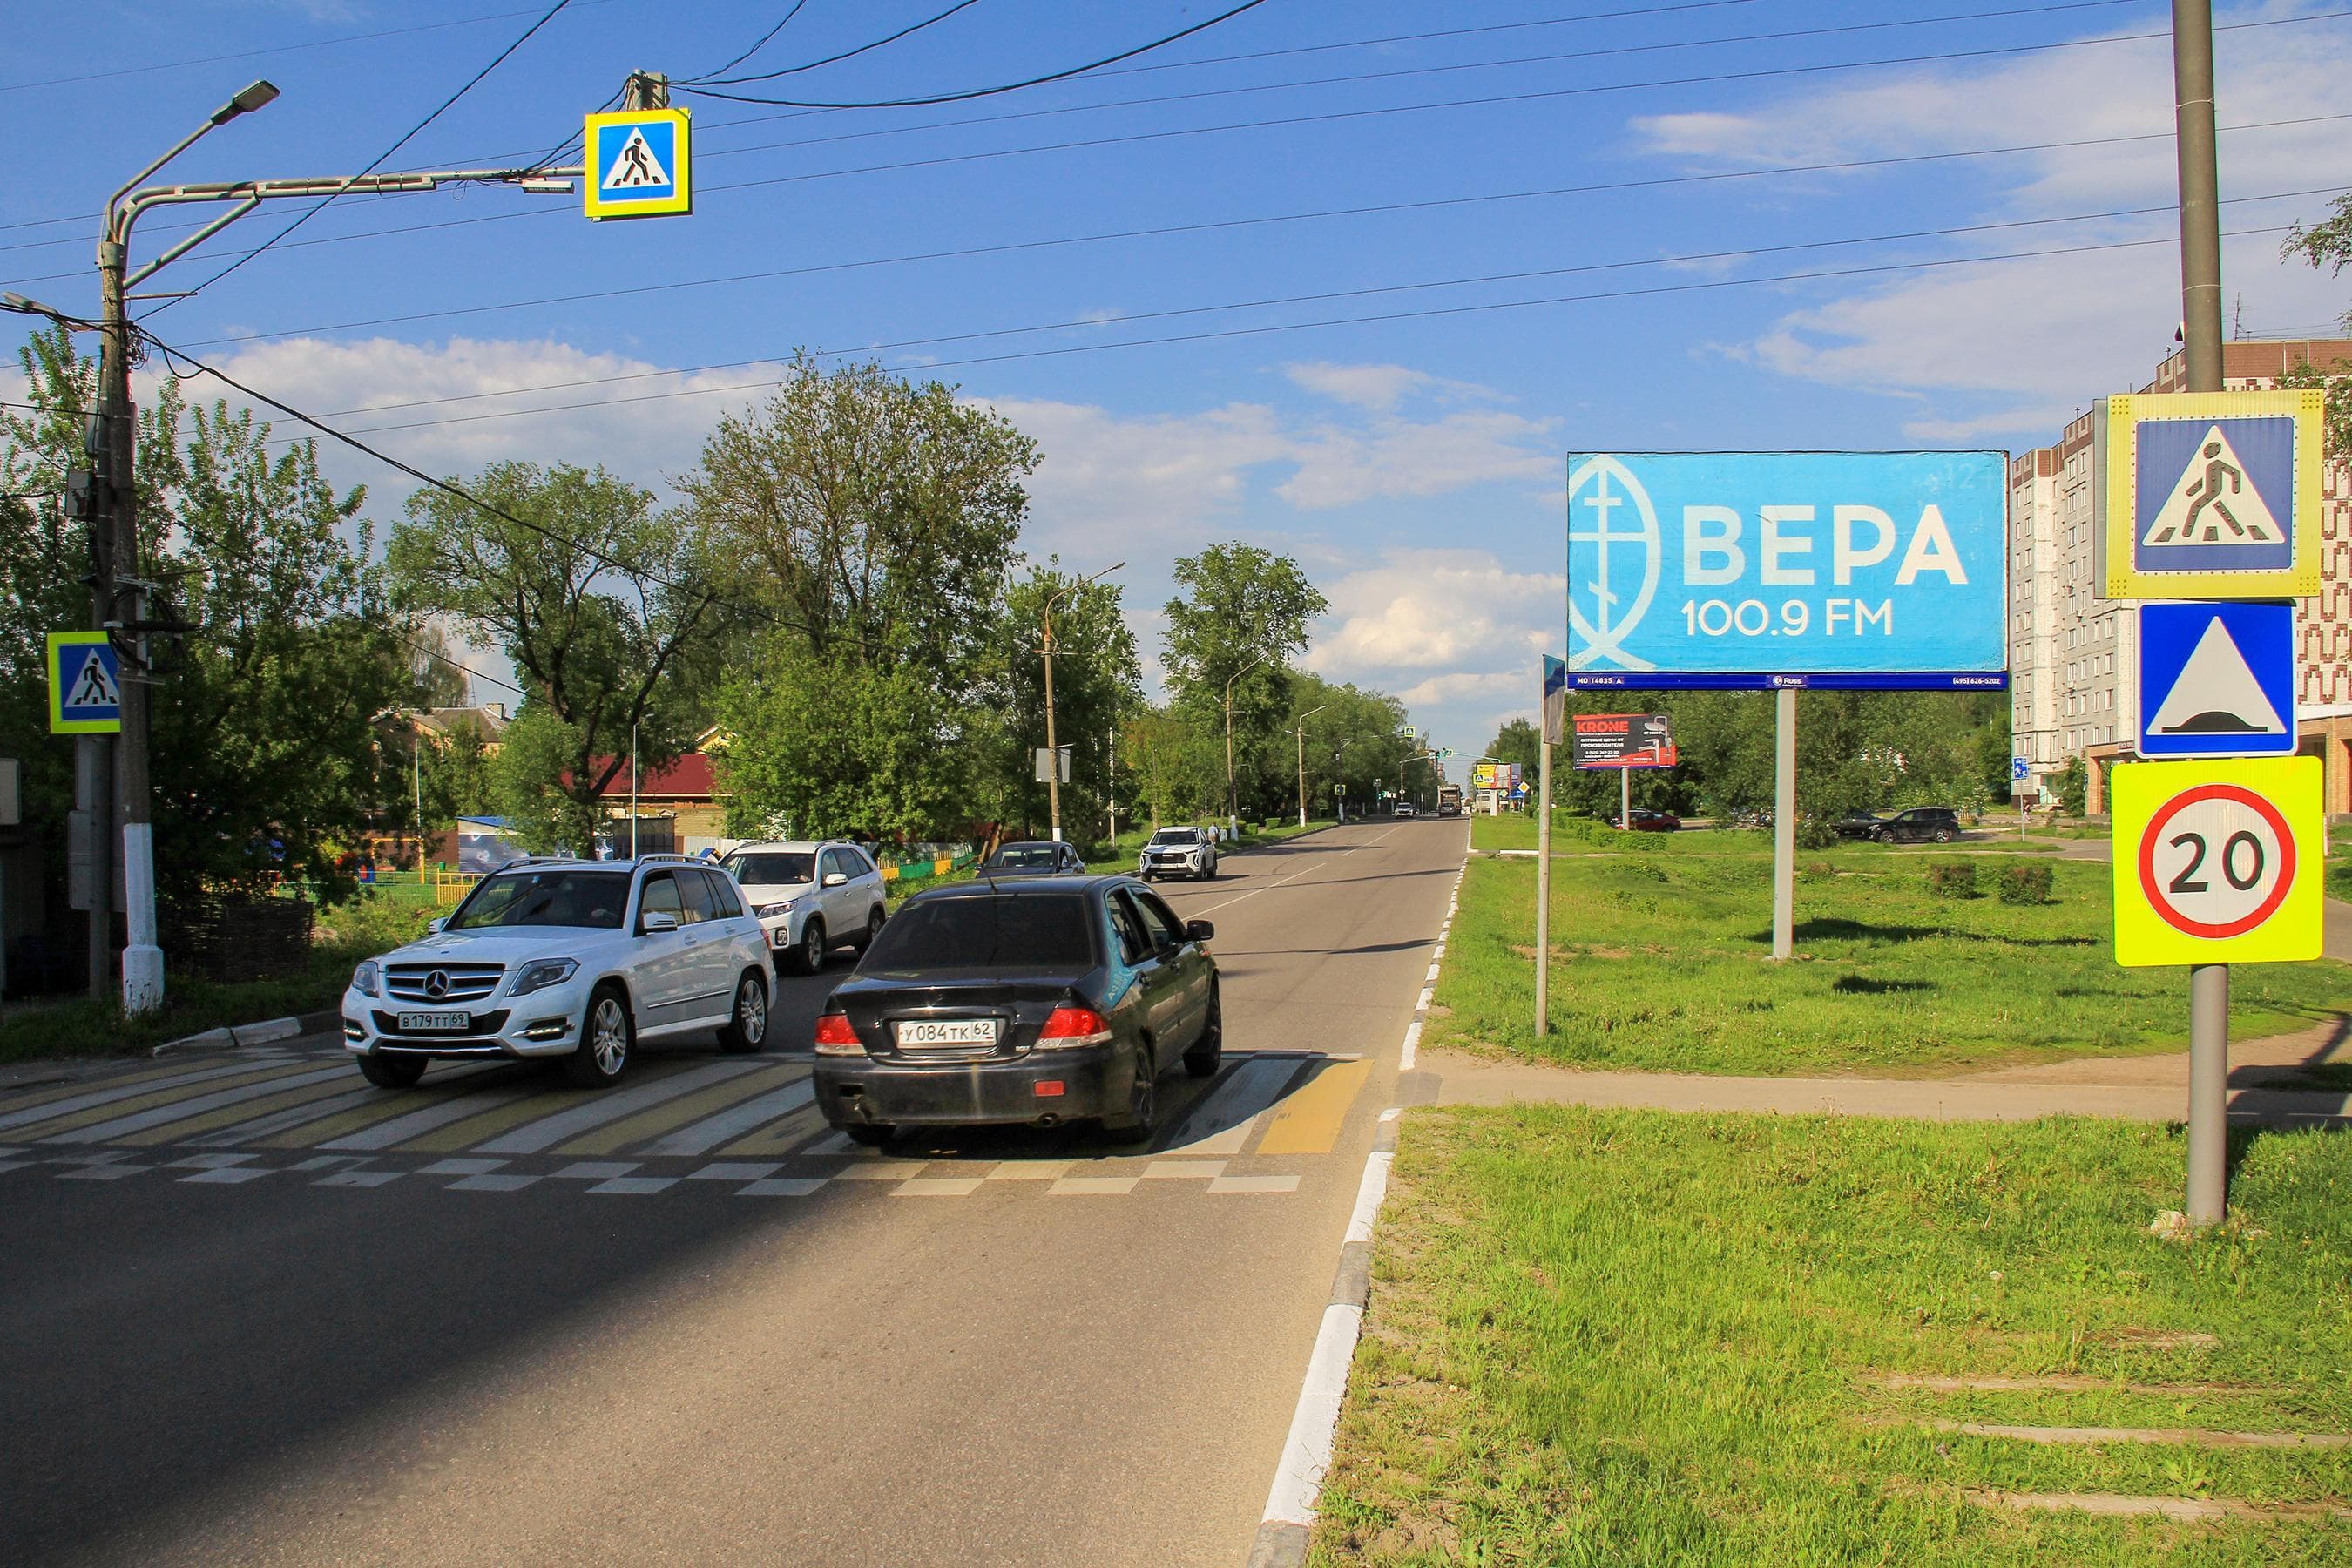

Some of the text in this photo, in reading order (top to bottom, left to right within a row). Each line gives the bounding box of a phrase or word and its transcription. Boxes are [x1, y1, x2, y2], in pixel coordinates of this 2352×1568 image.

[1683, 504, 1968, 585] ВЕРА
[1680, 599, 1891, 636] 100.9 FM
[1576, 721, 1629, 733] KRONE
[2169, 830, 2264, 893] 20
[973, 1023, 990, 1035] 62
